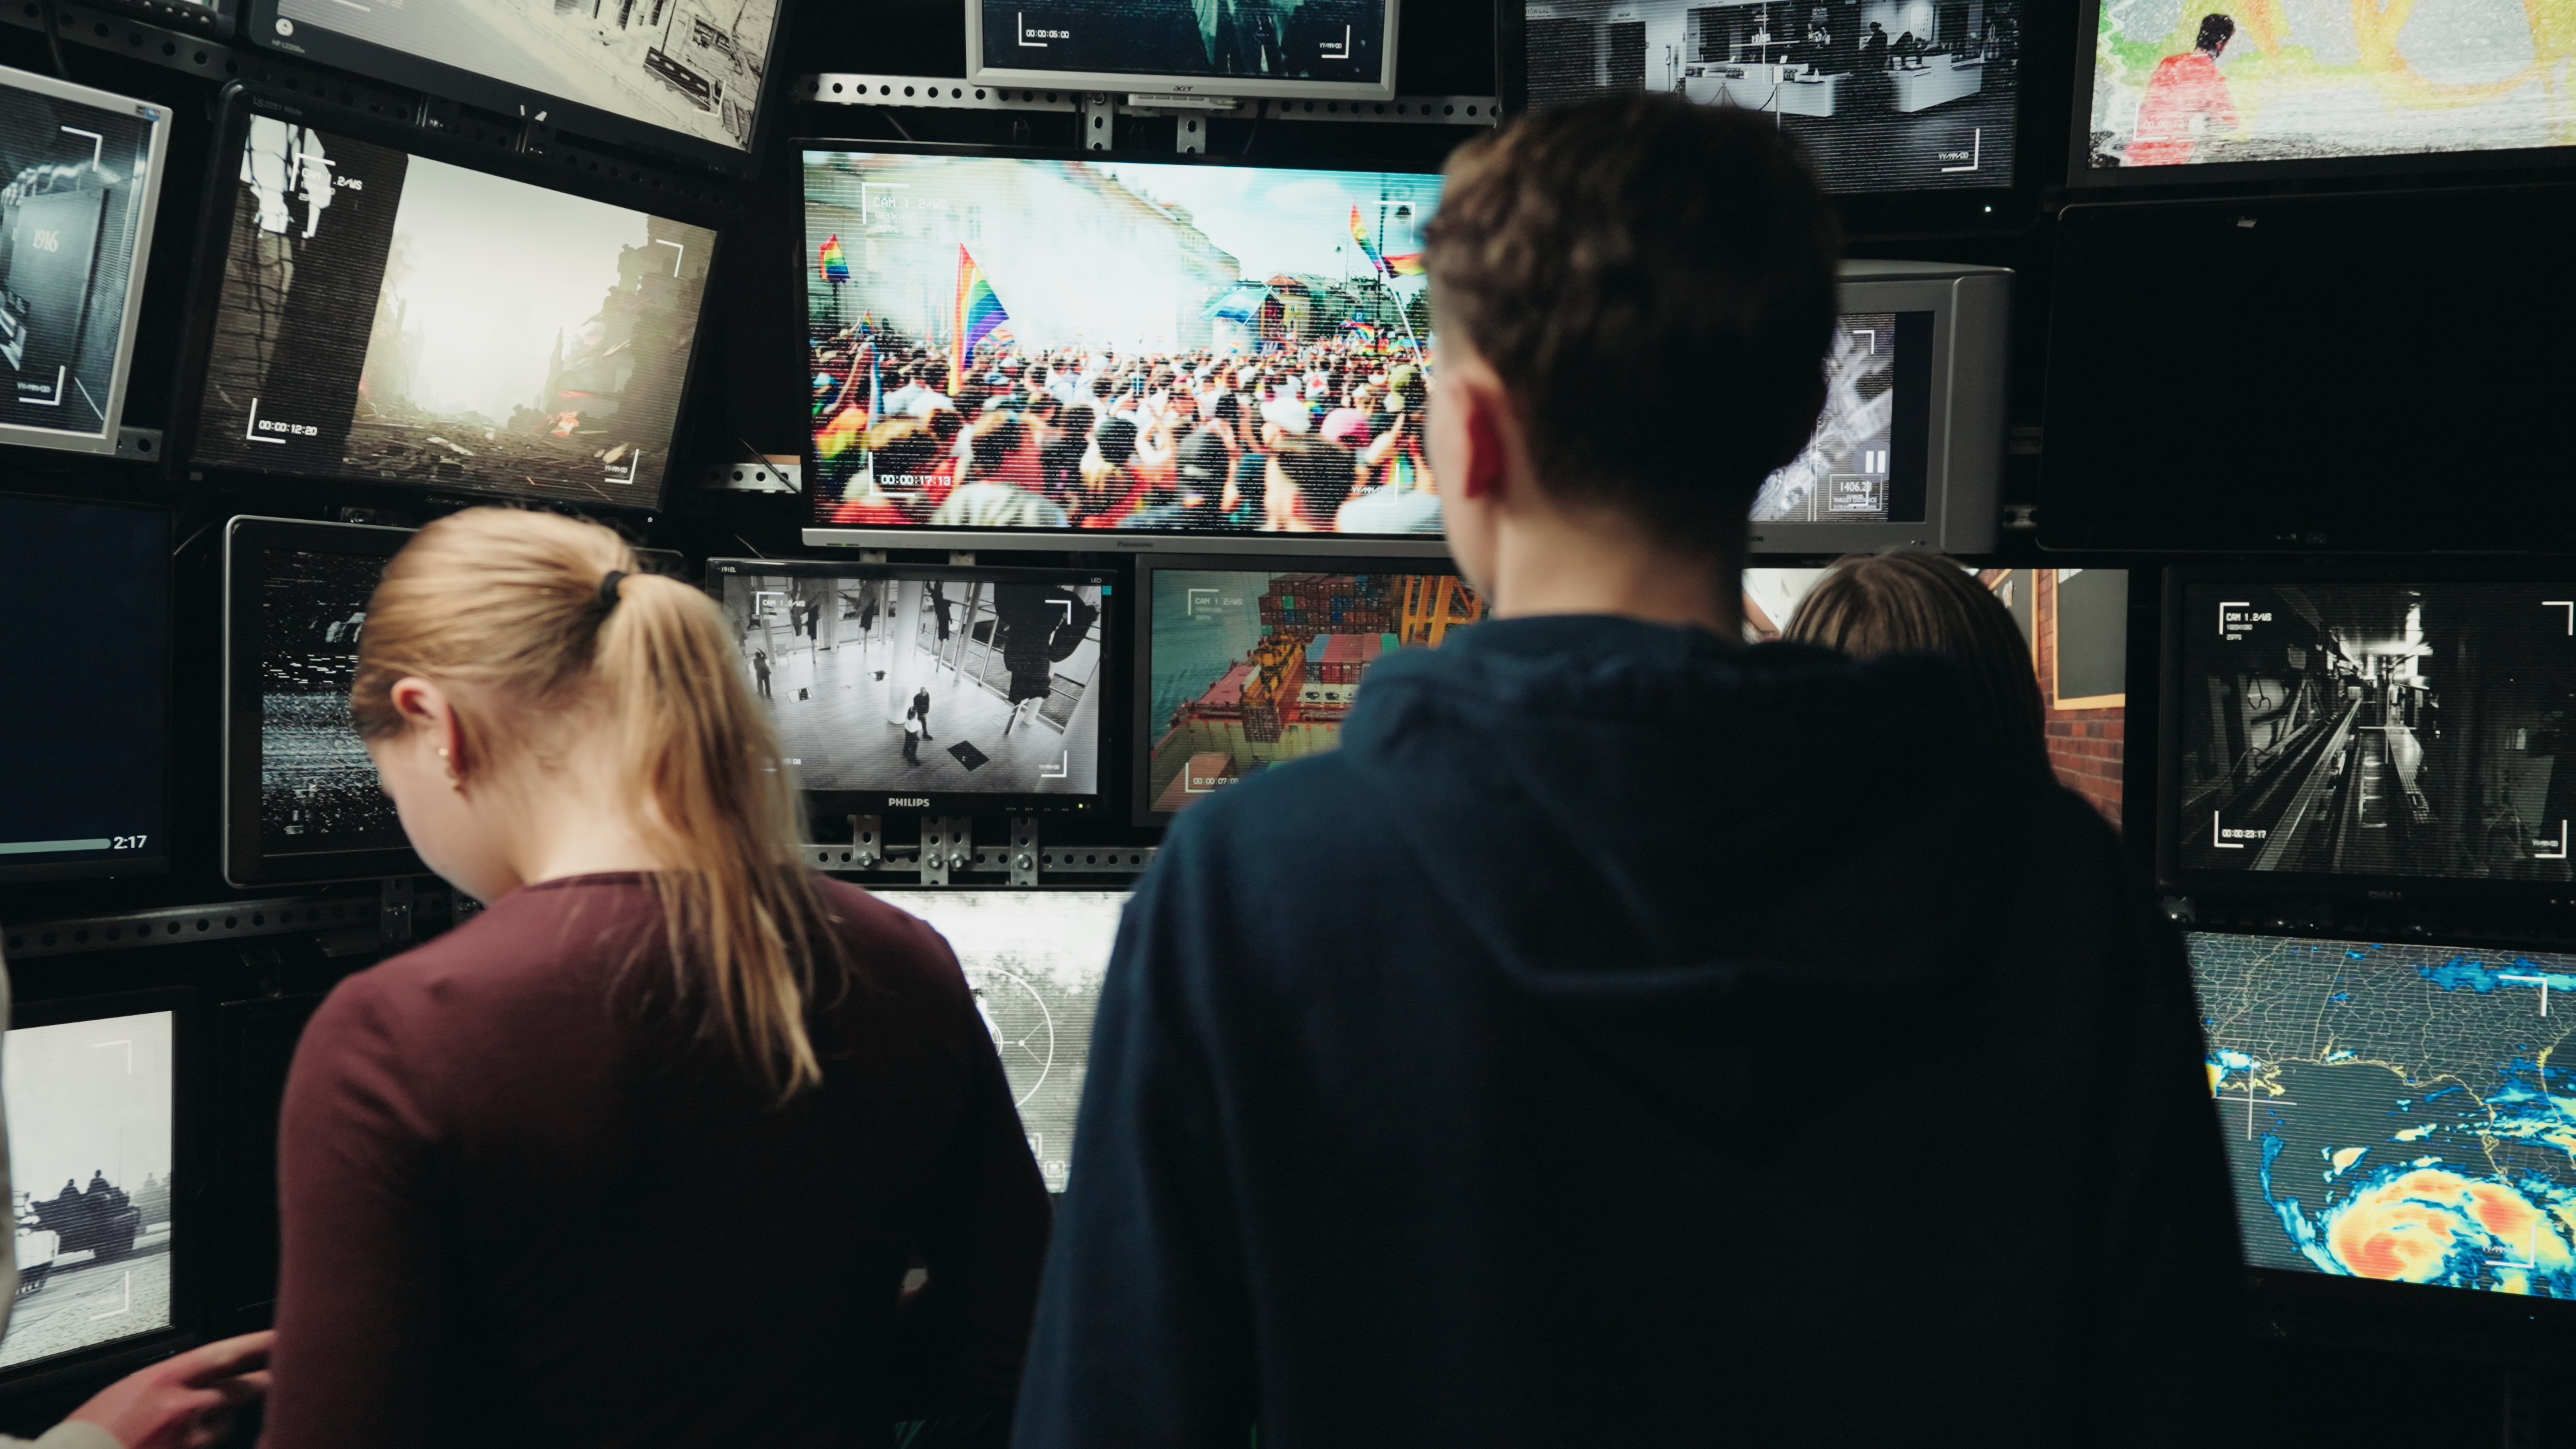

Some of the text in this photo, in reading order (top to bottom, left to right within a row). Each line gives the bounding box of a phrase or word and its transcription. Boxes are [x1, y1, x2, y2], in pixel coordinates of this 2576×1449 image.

[1026, 29, 1070, 38] 00:00:05:00
[873, 197, 949, 209] CAM 1.2/WS
[32, 229, 60, 253] 1916
[258, 420, 318, 436] 00:00:12:20
[881, 474, 951, 486] 00:00:17:13
[2226, 612, 2272, 622] CAM 1.2/WS
[888, 798, 930, 807] PHILIPS
[2221, 828, 2267, 839] 00:00:23:17
[113, 835, 148, 850] 2:17
